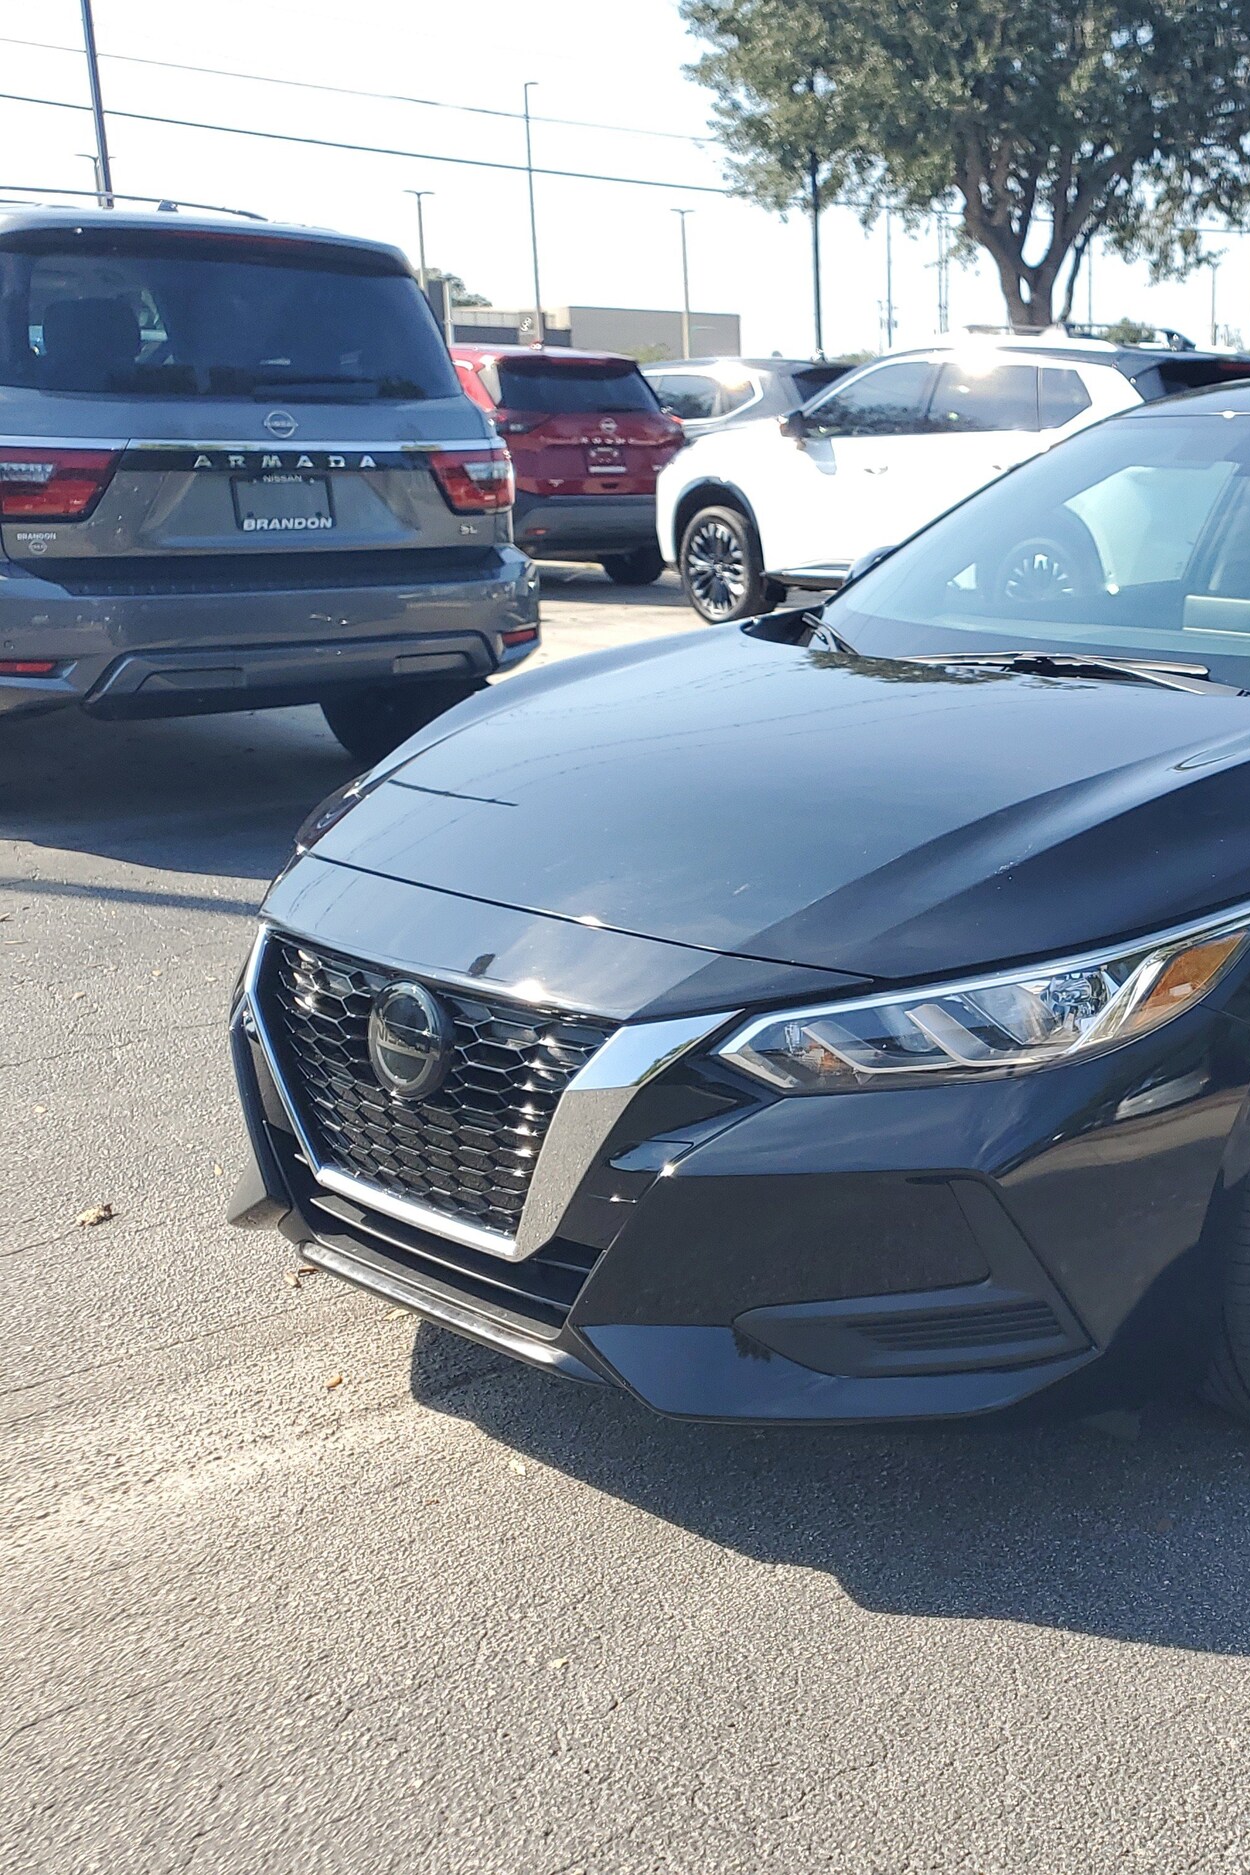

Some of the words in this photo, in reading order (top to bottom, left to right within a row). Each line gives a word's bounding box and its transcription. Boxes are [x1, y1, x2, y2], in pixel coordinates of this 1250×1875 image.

[193, 455, 376, 468] ARMADA
[262, 475, 302, 483] NISSAN
[243, 517, 333, 531] BRANDON
[16, 532, 57, 541] BRANDON
